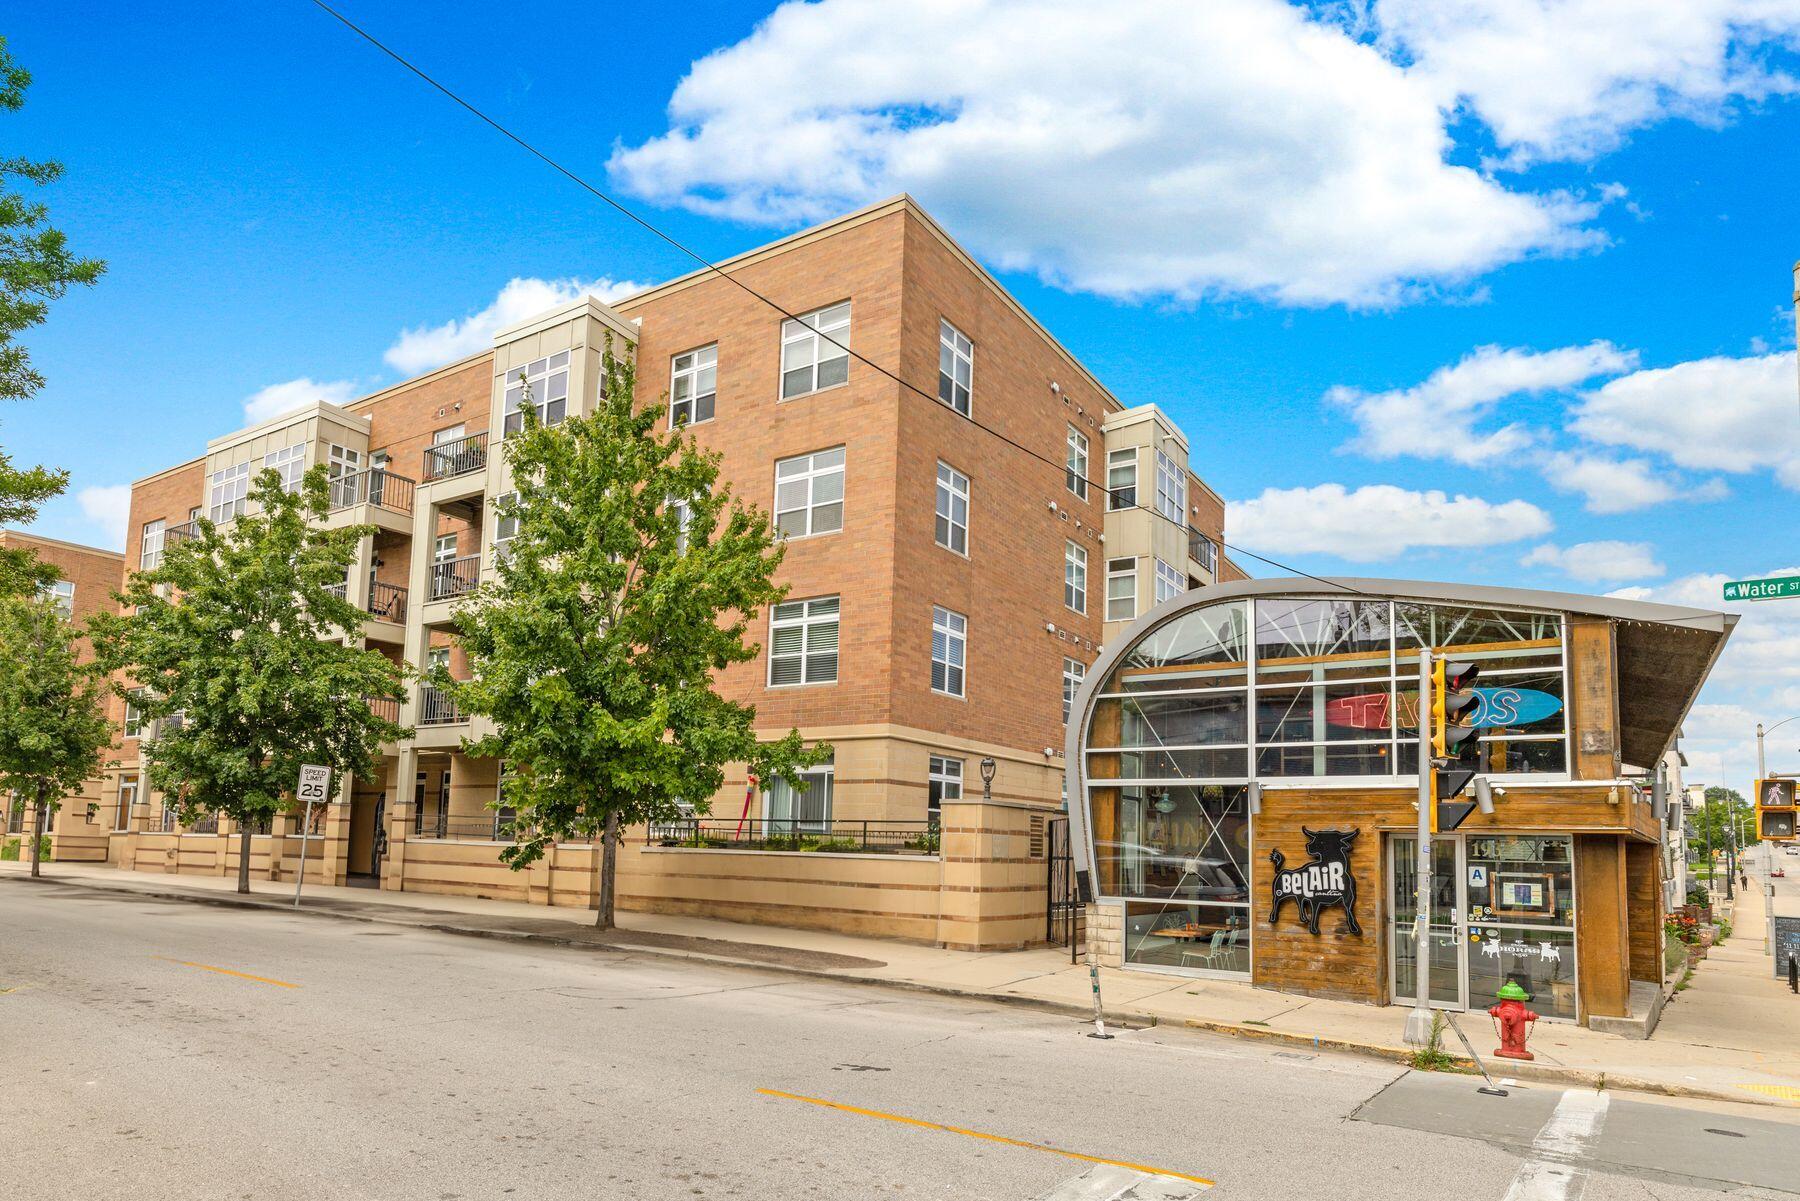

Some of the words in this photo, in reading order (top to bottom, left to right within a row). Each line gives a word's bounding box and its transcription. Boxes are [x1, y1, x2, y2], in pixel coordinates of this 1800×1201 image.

[1738, 582, 1784, 597] Water
[1790, 582, 1800, 590] ST
[301, 784, 324, 797] 25
[1472, 869, 1483, 880] A
